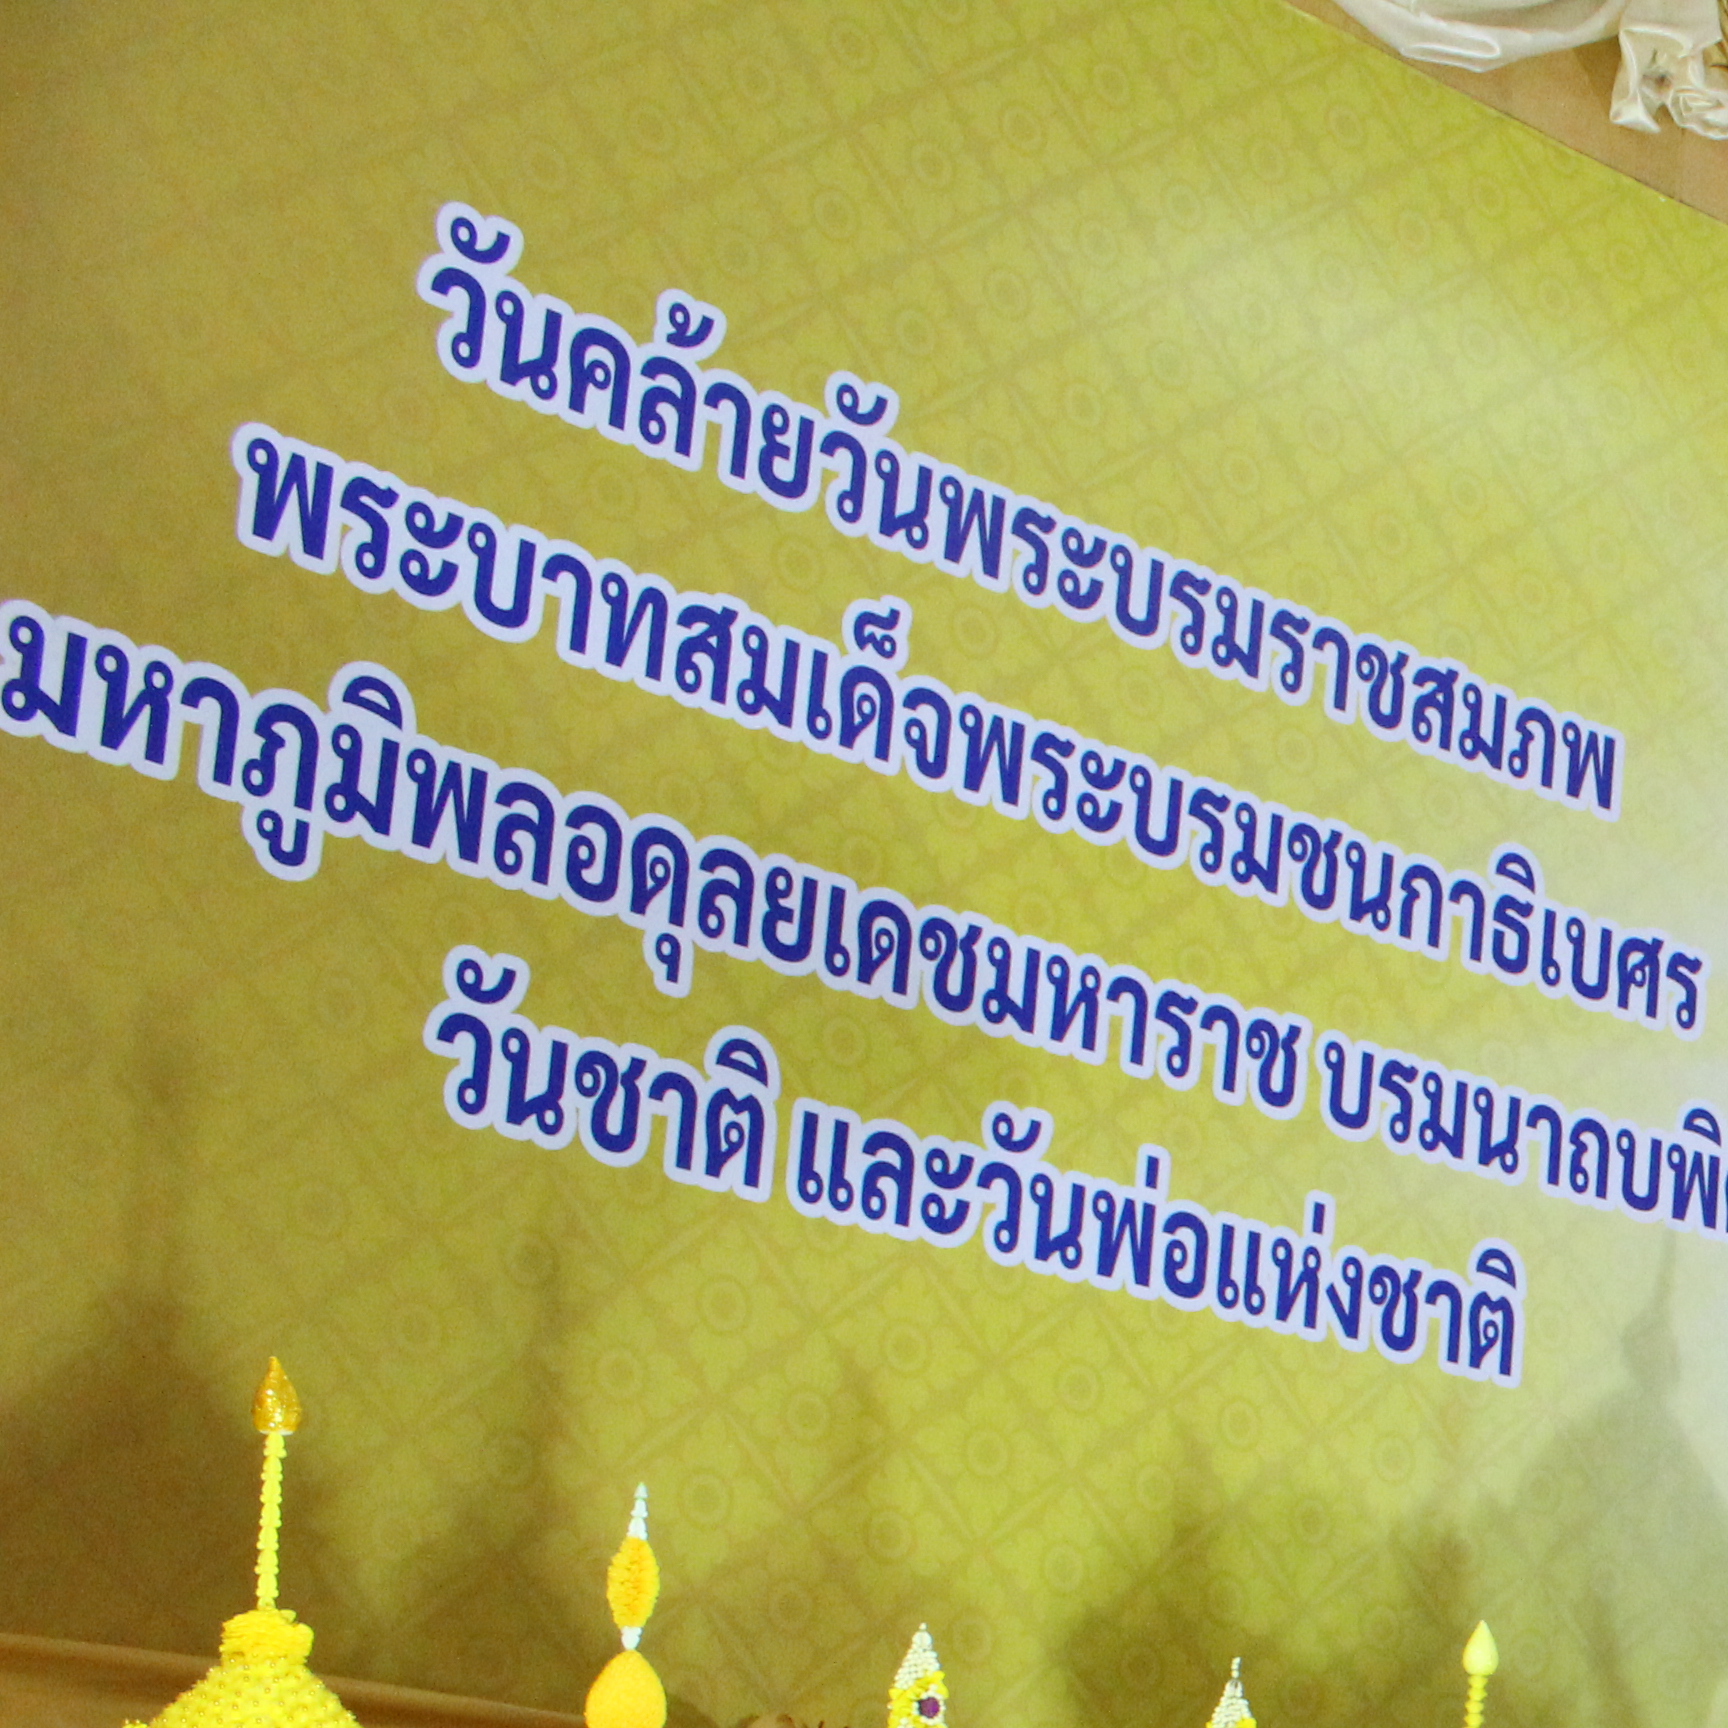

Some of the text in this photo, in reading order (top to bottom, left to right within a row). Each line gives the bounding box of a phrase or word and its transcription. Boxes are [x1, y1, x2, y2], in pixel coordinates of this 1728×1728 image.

[246, 435, 1705, 1031] พระบาทสมเด็จพระบรมชนกาธิเบศร
[429, 215, 1617, 810] วันคล้ายวันพระบรมราชสมภพ
[2, 613, 1304, 1109] มหาภูมิพลอดุลยเดชมหาราช
[435, 956, 1519, 1379] วันชาติ และวันพ่อแห่งชาติ
